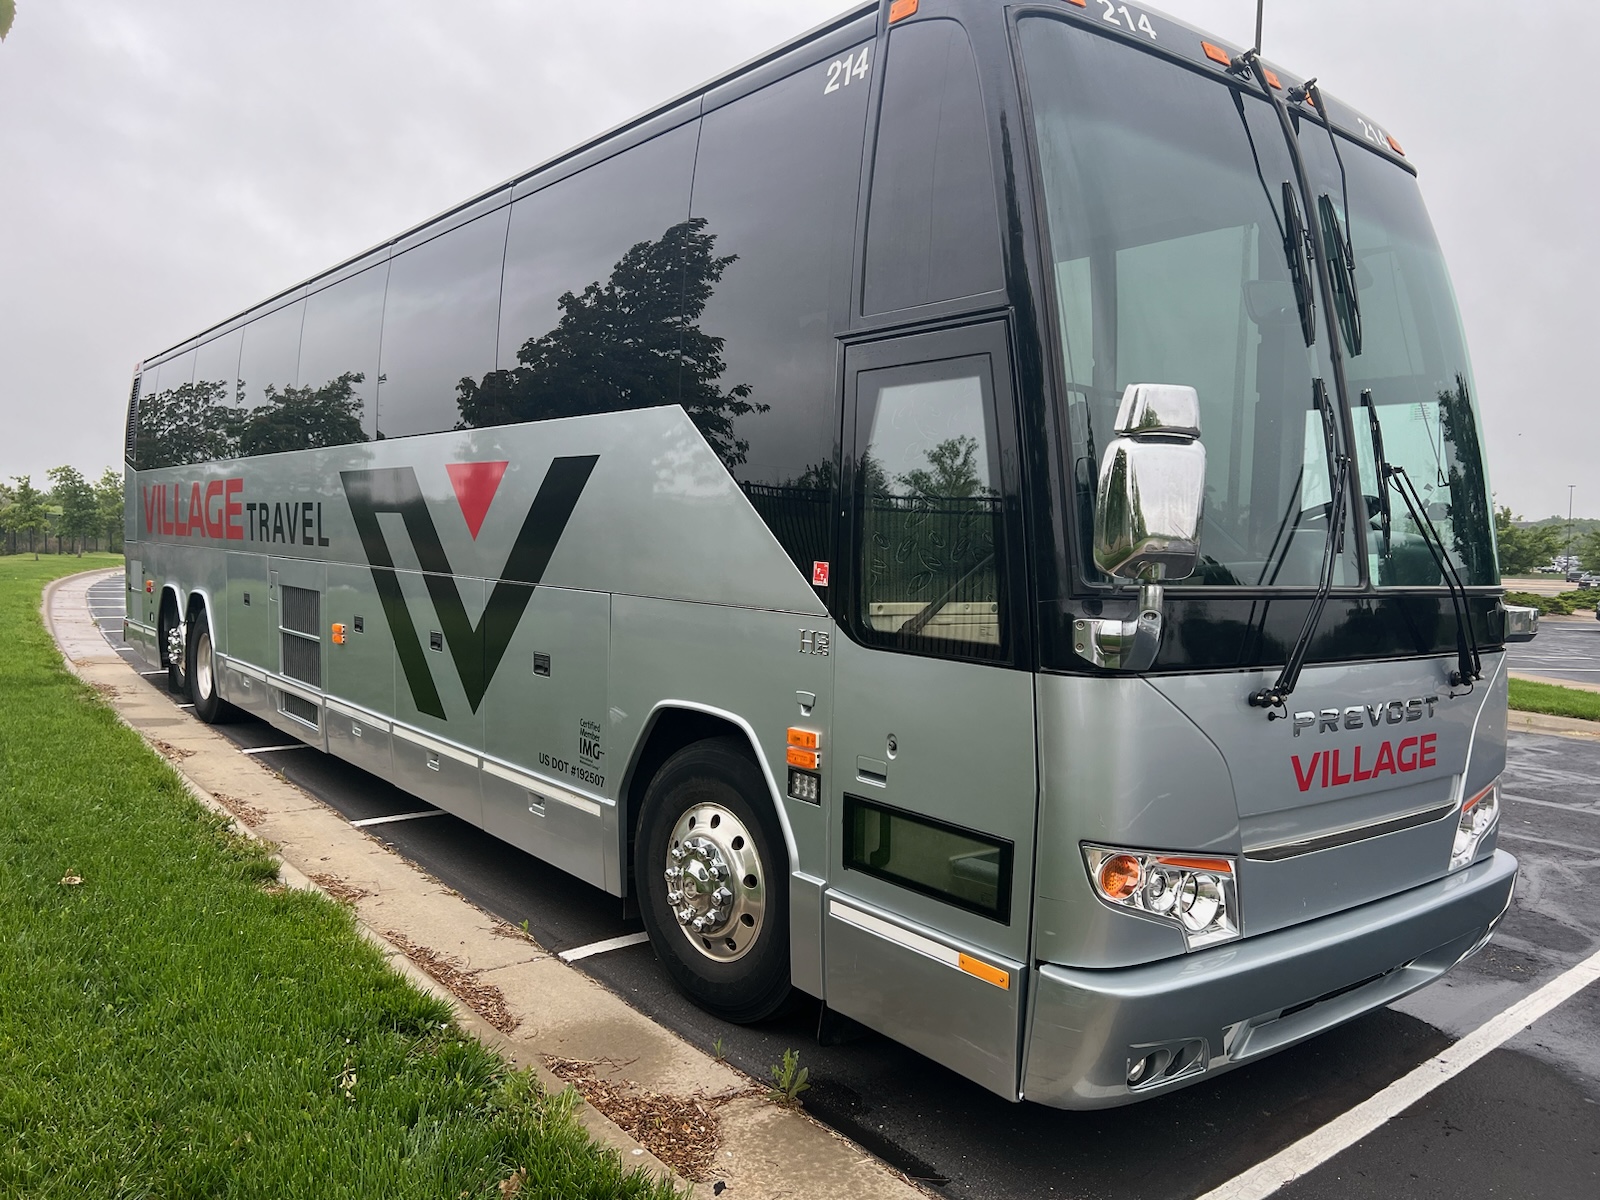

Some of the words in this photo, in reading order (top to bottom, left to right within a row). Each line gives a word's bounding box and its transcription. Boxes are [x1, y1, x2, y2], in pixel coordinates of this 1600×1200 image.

[1097, 0, 1157, 40] 214
[823, 46, 869, 95] 214
[1357, 117, 1391, 151] 214
[143, 478, 244, 540] VILLAGE
[246, 502, 330, 547] TRAVEL
[580, 718, 601, 733] Certified
[580, 728, 600, 742] Member
[1293, 696, 1439, 738] PREVOST
[579, 737, 605, 760] IMG
[1290, 732, 1438, 792] VILLAGE
[539, 752, 550, 767] US
[551, 757, 569, 774] DOT
[571, 765, 605, 788] #192507
